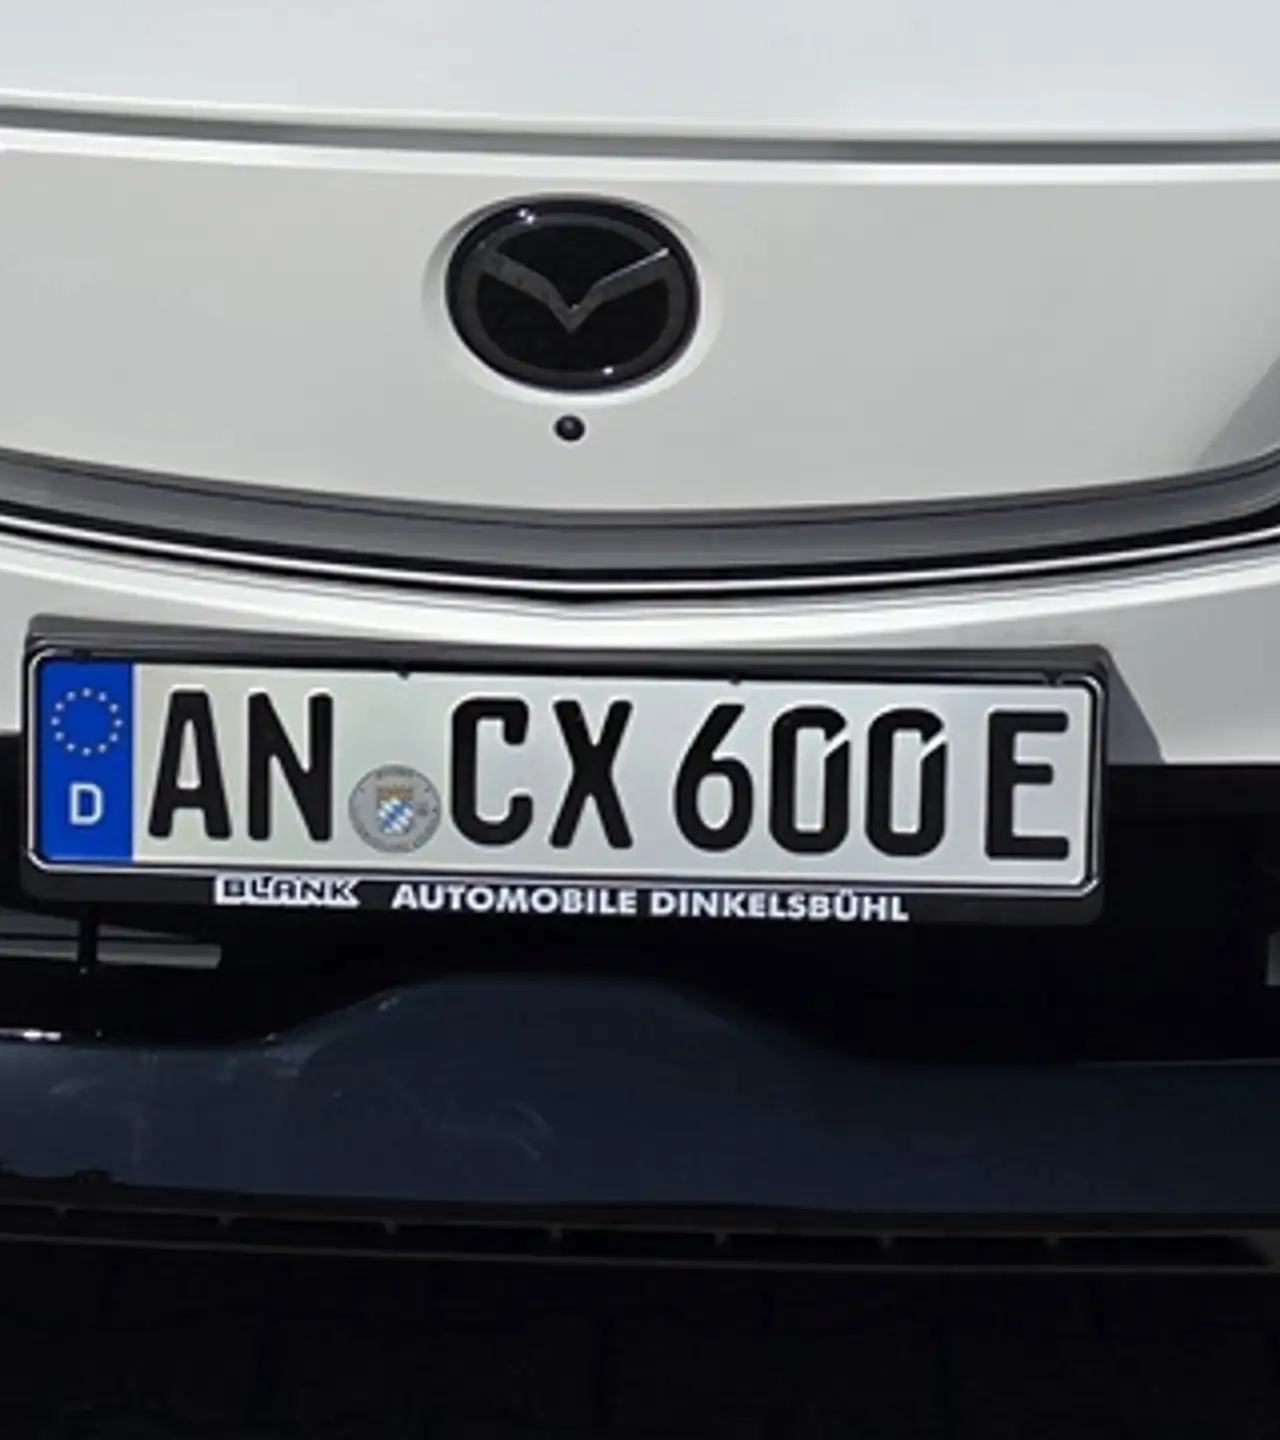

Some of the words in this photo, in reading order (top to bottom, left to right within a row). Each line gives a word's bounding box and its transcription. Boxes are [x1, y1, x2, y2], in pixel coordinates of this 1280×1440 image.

[149, 691, 333, 842] AN
[451, 698, 633, 848] CX
[68, 782, 105, 826] D
[216, 875, 360, 906] BLANK
[391, 883, 637, 915] AUTOMOBILE
[651, 889, 908, 921] DINKELSBÜHL
